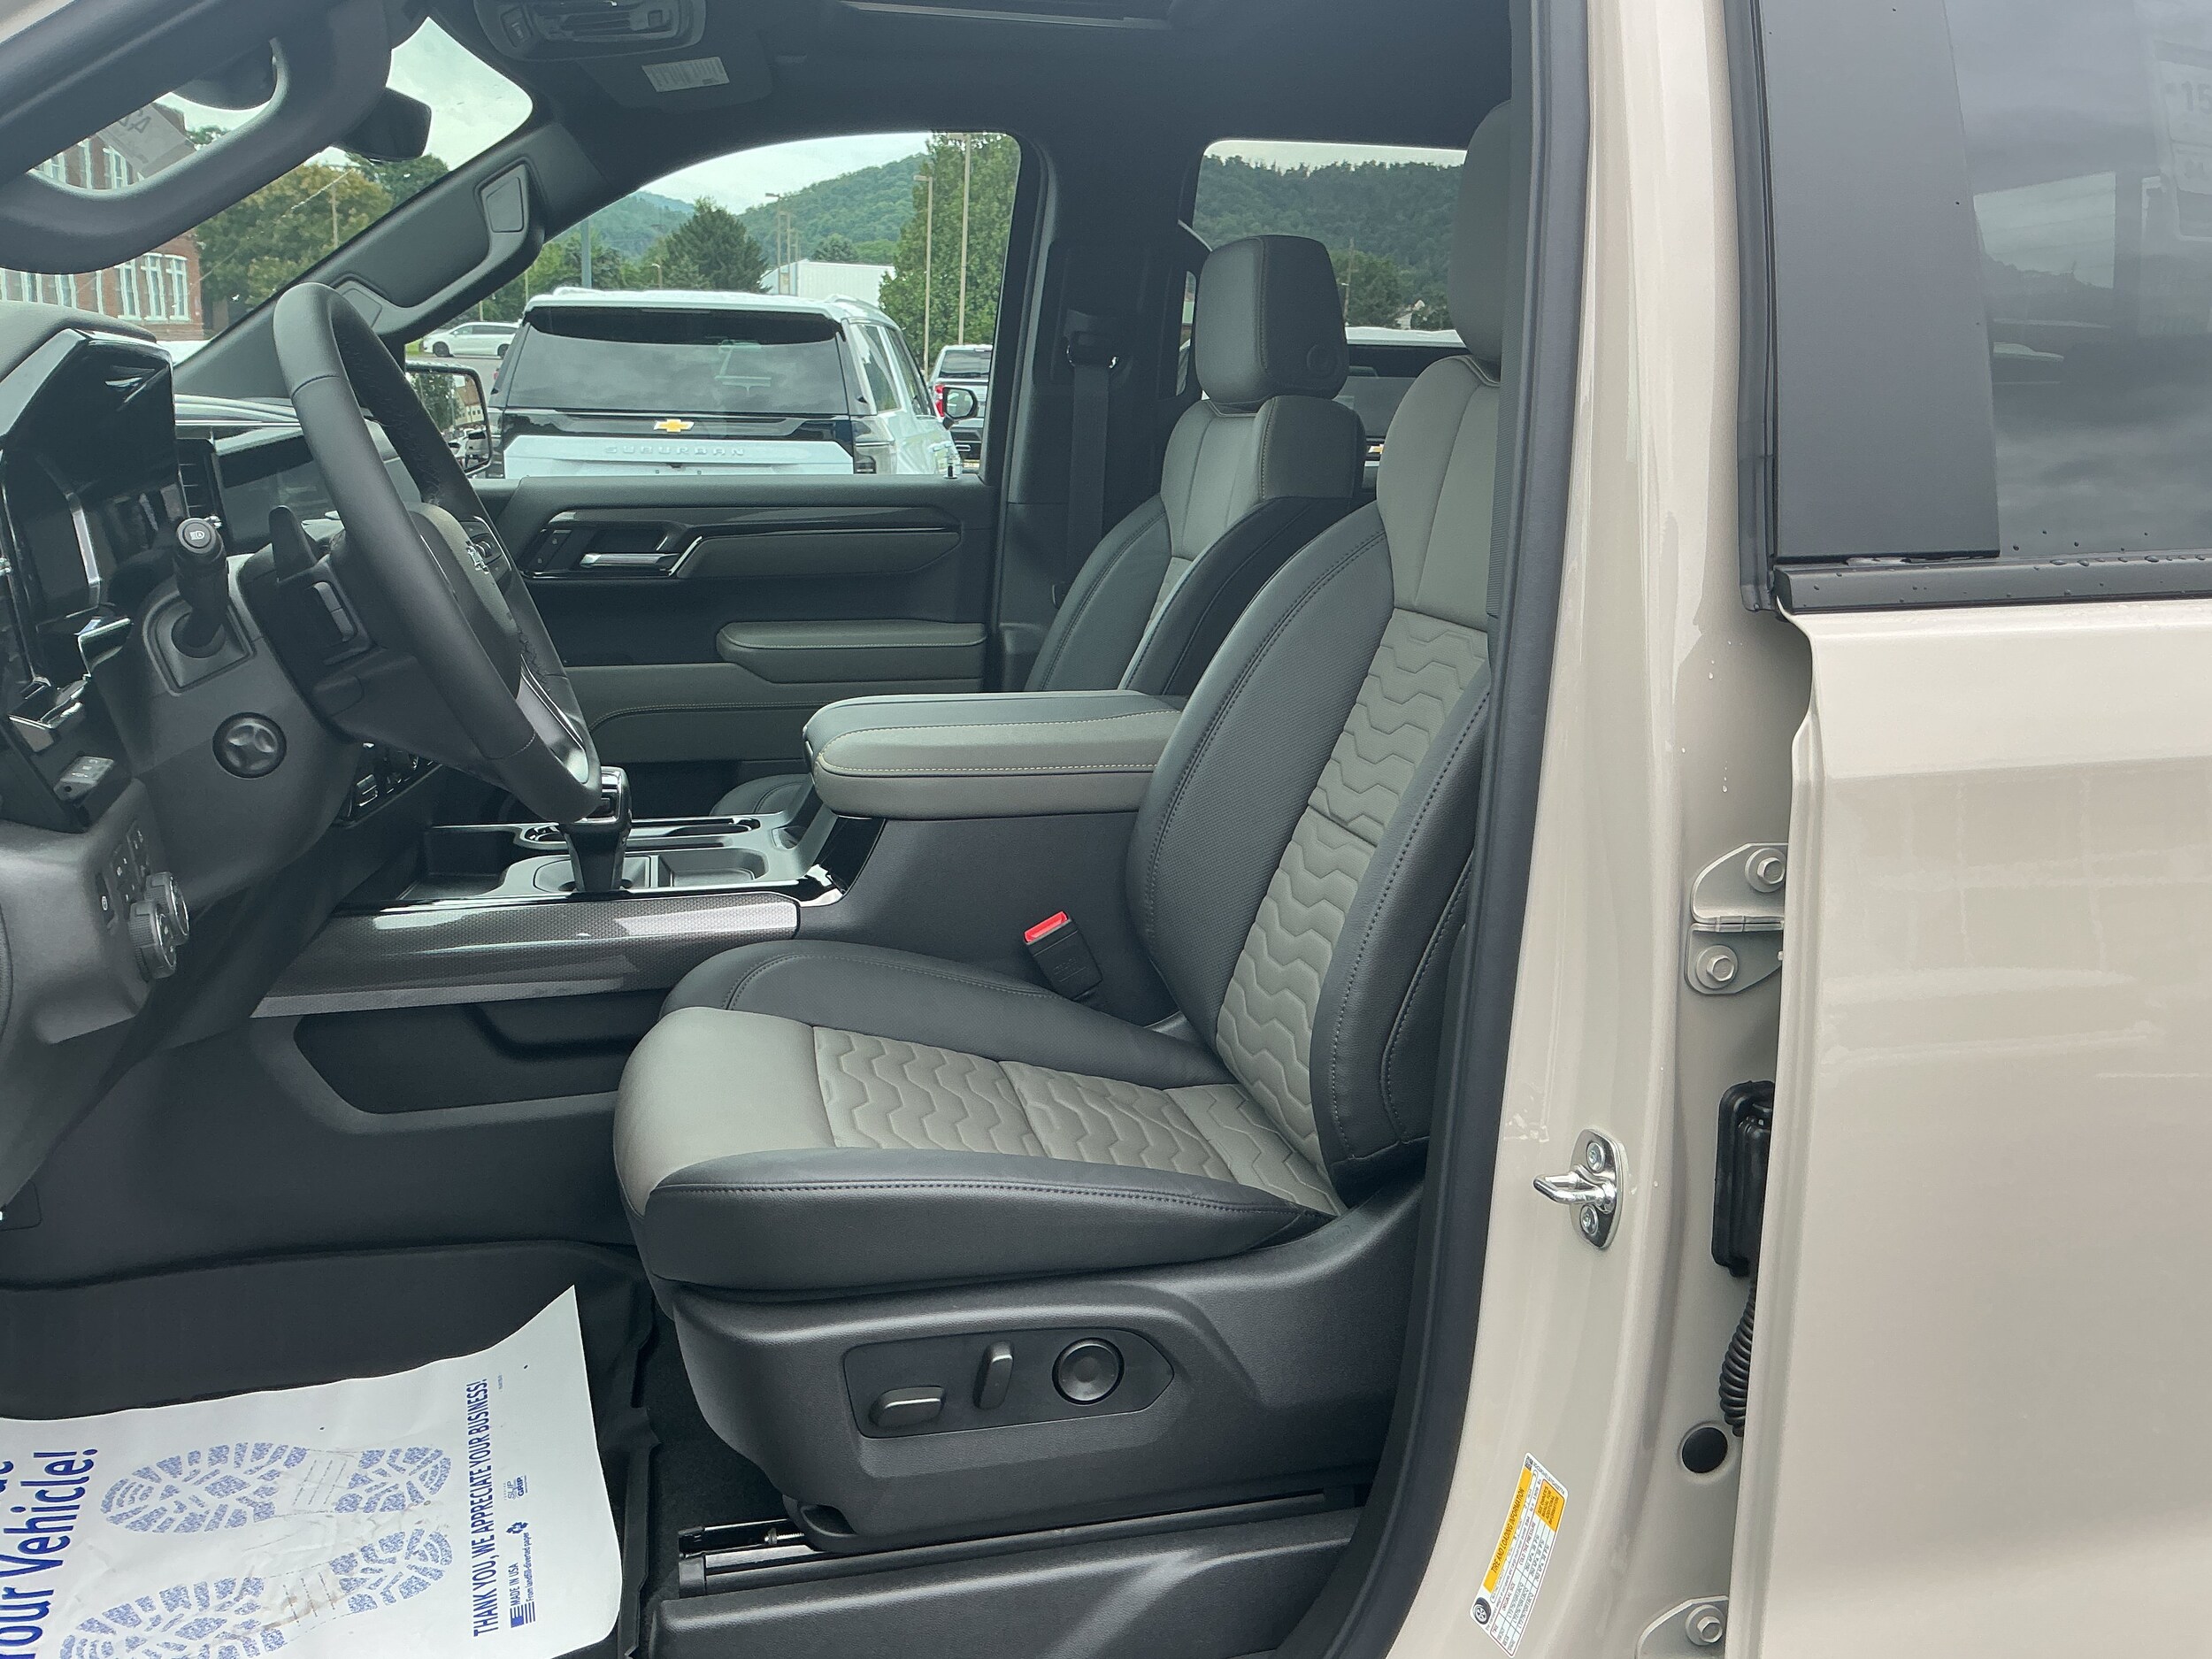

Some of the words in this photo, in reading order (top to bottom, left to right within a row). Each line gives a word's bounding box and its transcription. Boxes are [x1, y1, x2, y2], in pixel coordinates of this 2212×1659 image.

[604, 445, 745, 457] SUBURBAN
[466, 1379, 489, 1435] BUSINESS!
[468, 1434, 491, 1468] YOUR
[0, 1449, 97, 1577] Vehicle!
[469, 1465, 494, 1533] APPRECIATE
[472, 1534, 495, 1558] WE
[523, 1532, 533, 1546] paper
[1491, 1558, 1500, 1572] TIRE
[1501, 1524, 1512, 1548] LOADING
[1509, 1487, 1524, 1524] INFORMATION
[1526, 1521, 1535, 1543] PRESSURE
[472, 1555, 499, 1591] YOU,
[509, 1563, 518, 1578] USA
[522, 1547, 534, 1587] landfill-diverted
[510, 1586, 520, 1606] MADE
[526, 1587, 534, 1601] From
[0, 1586, 54, 1659] our
[473, 1588, 498, 1637] THANK
